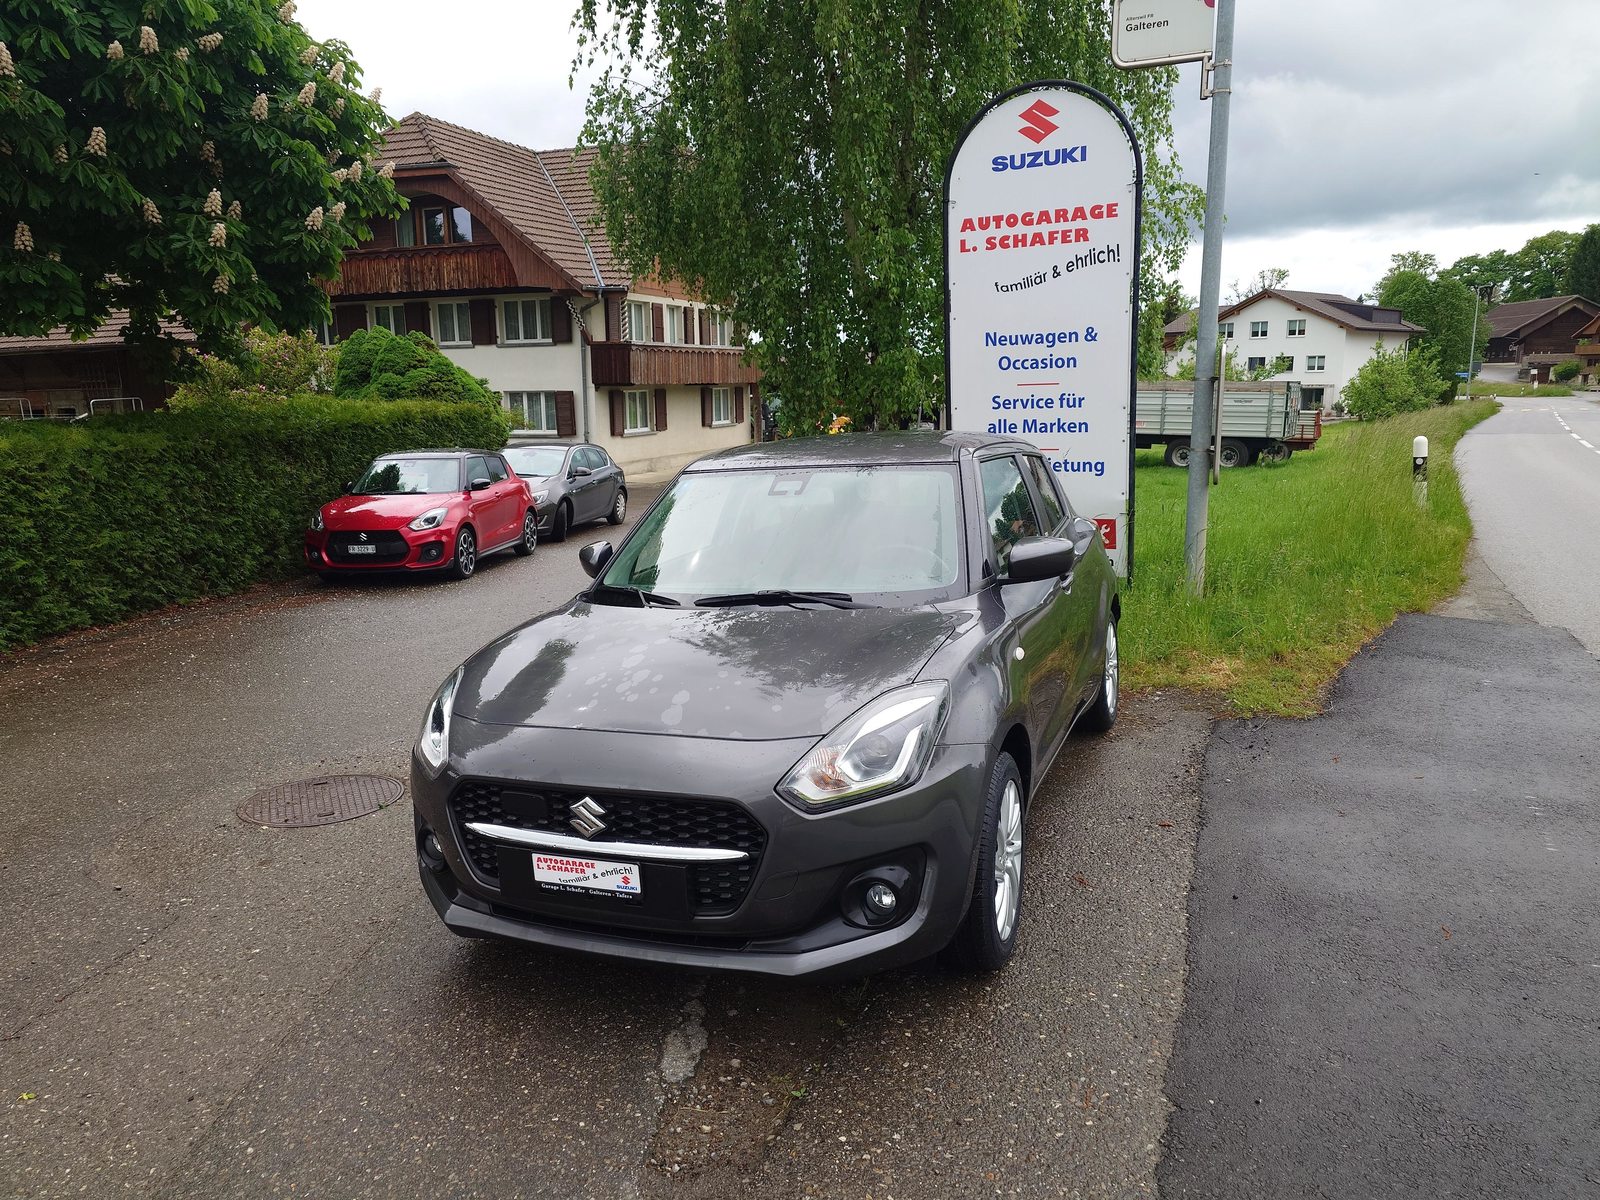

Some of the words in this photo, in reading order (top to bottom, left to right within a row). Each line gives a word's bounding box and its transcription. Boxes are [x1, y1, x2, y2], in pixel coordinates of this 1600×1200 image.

[1125, 20, 1169, 32] Galteren
[991, 145, 1088, 172] SUZUKI
[960, 202, 1119, 233] AUTOGARAGE
[959, 239, 978, 253] L.
[985, 227, 1090, 251] SCHAFER
[994, 271, 1048, 293] familiär
[1052, 265, 1062, 279] &
[1066, 243, 1121, 273] ehrlich!
[985, 330, 1079, 348] Neuwagen
[1084, 326, 1098, 342] &
[998, 353, 1077, 371] Occasion
[991, 394, 1055, 410] Service
[1059, 393, 1085, 408] für
[987, 419, 1018, 434] alle
[1022, 418, 1089, 434] Marken
[1048, 458, 1105, 476] ietung
[536, 856, 596, 869] AUTOGARAGE
[546, 864, 586, 874] SCHAFER
[558, 874, 591, 884] familiär
[592, 872, 599, 880] &
[600, 866, 633, 878] ehrlich!
[541, 882, 559, 890] Garage
